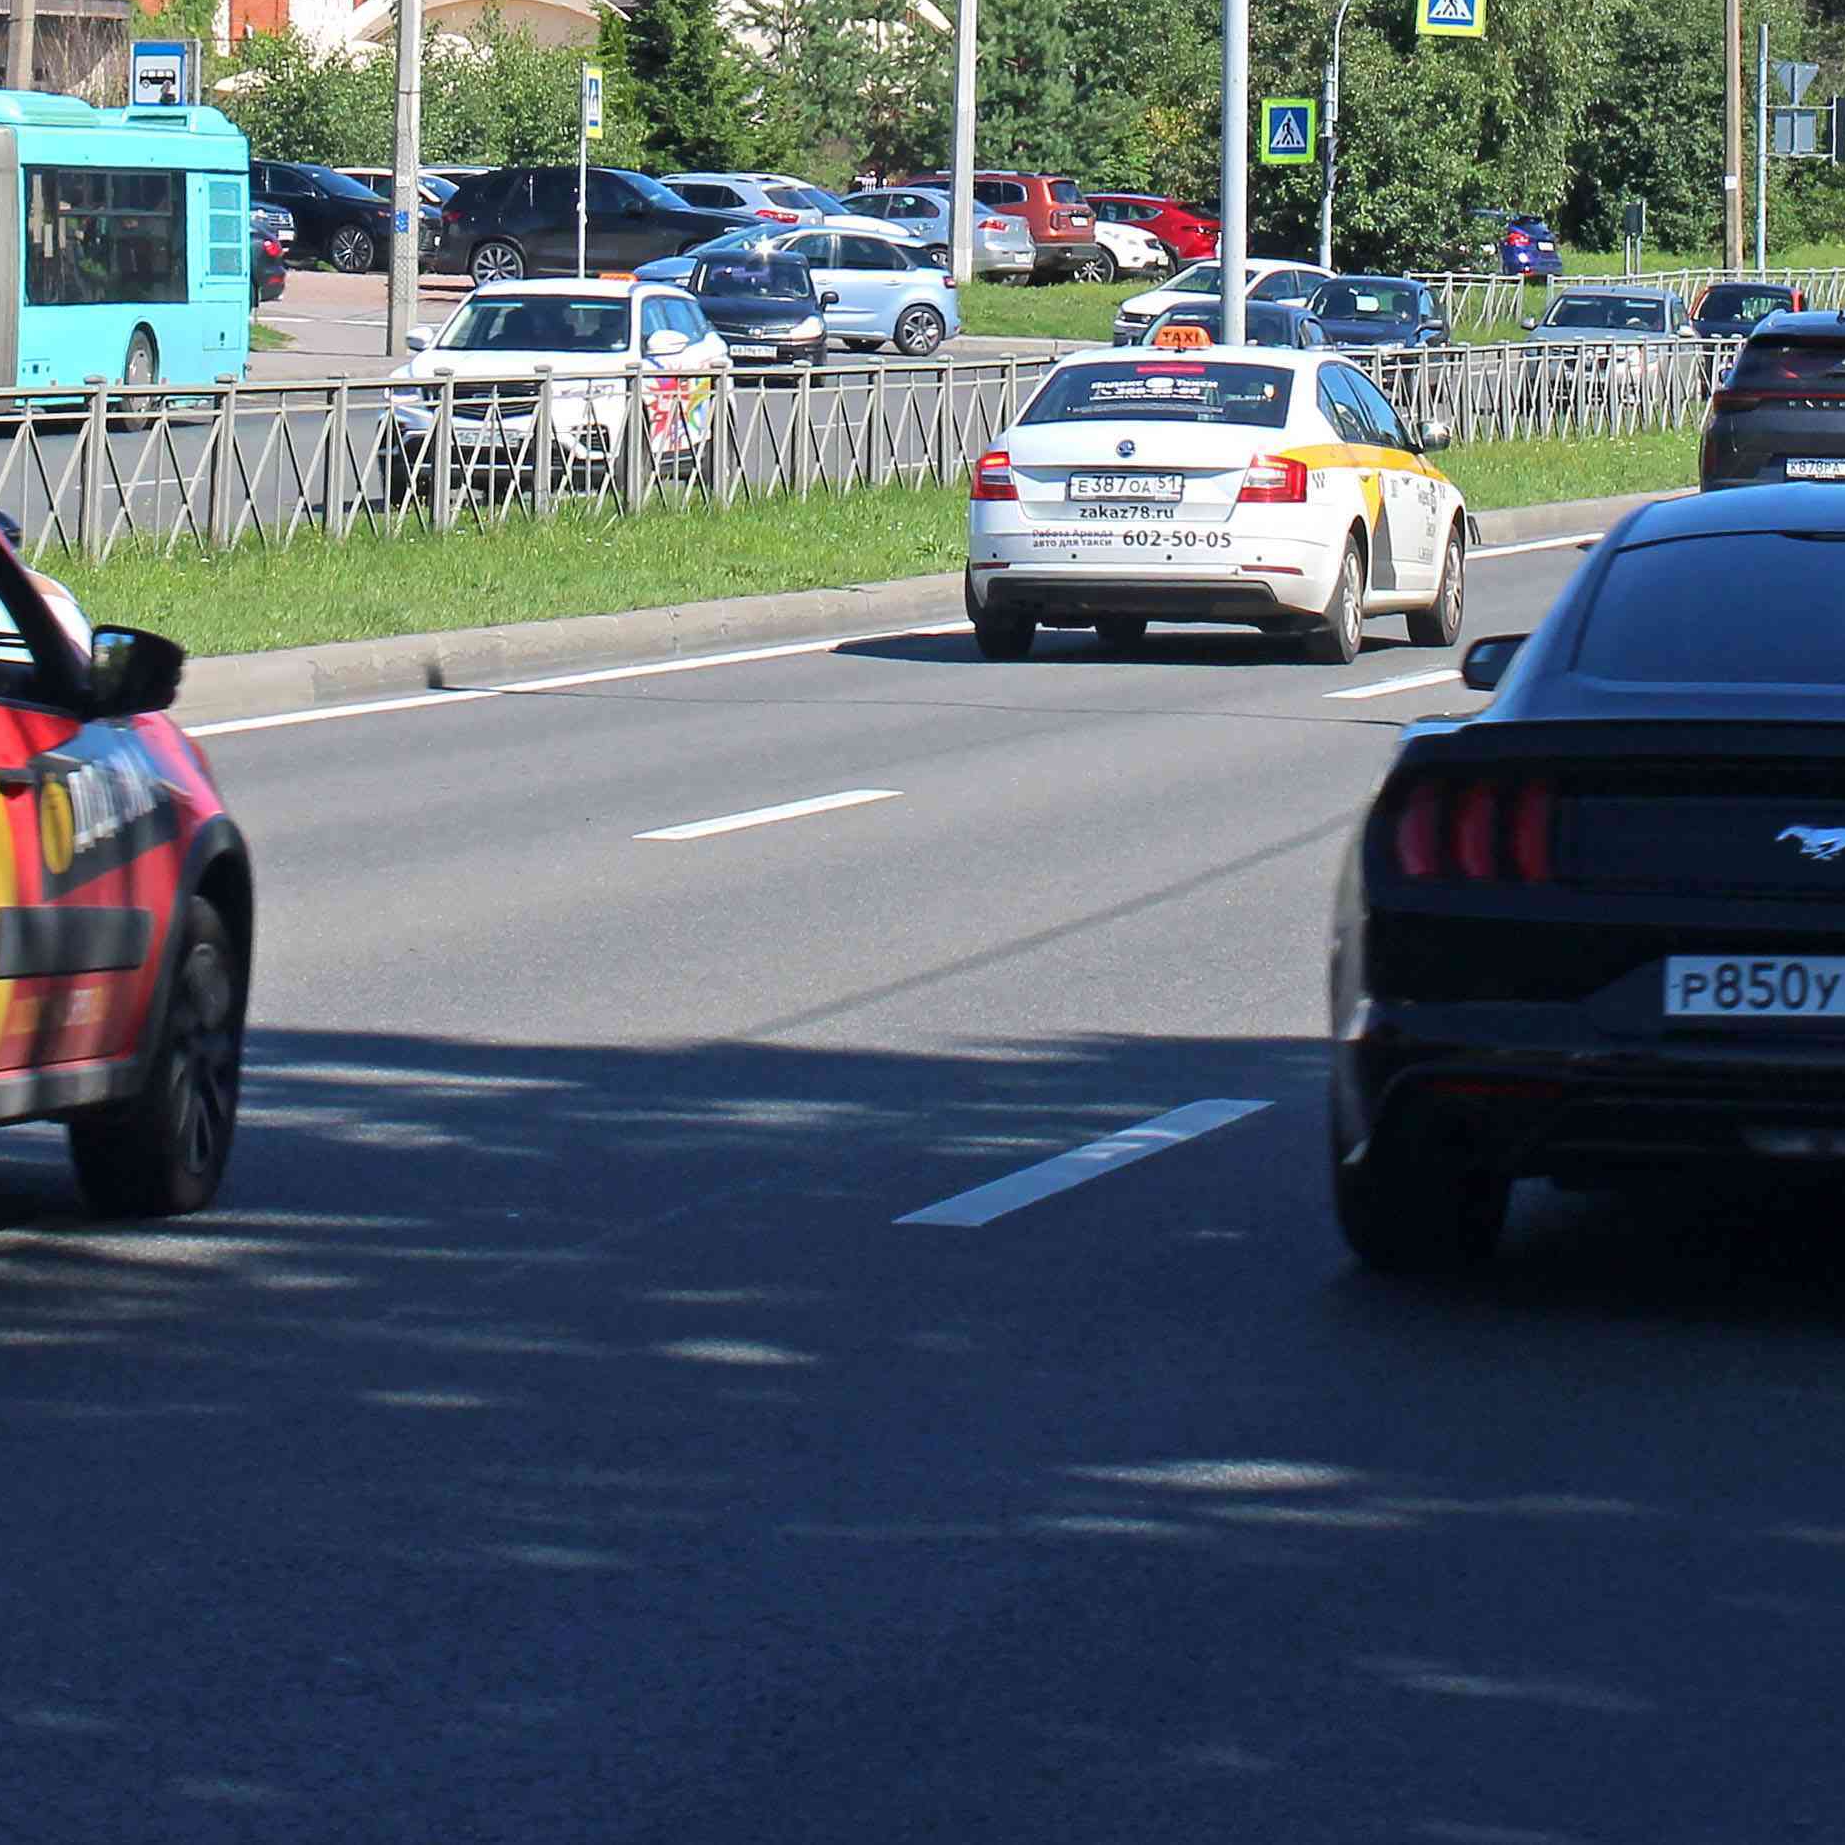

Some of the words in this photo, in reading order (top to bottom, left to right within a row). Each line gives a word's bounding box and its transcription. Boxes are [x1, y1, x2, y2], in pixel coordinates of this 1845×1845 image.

[1162, 330, 1200, 343] TAXI
[1079, 505, 1175, 520] zakaz78.ru
[1031, 528, 1071, 538] Работа
[1072, 529, 1114, 540] Аренда
[1122, 530, 1232, 549] 602-50-05
[1033, 539, 1058, 548] авто
[1059, 539, 1080, 548] для
[1081, 538, 1113, 547] такси
